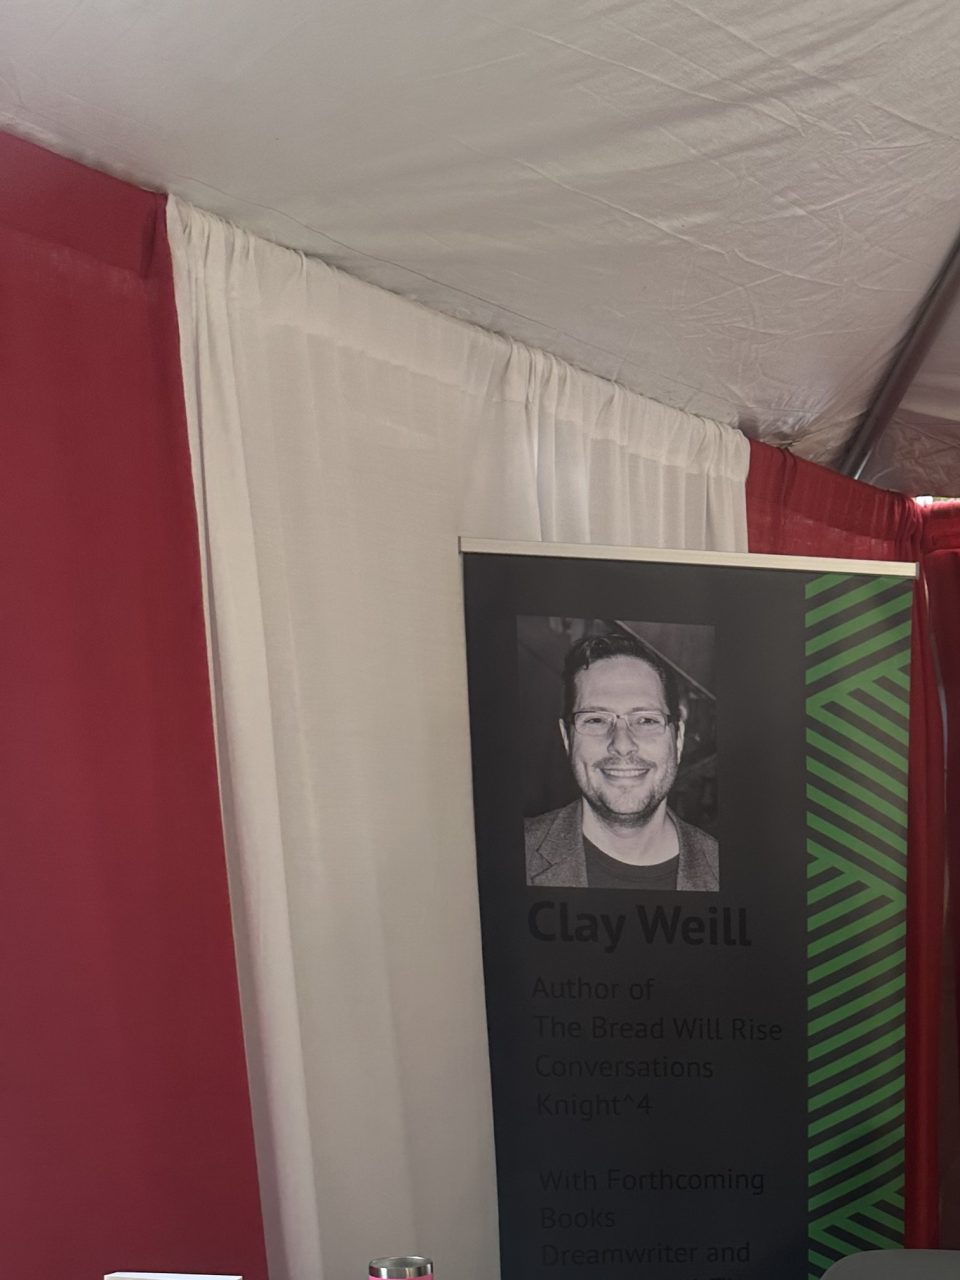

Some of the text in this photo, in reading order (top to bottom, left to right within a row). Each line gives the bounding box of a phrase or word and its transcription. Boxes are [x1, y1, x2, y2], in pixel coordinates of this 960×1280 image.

[528, 900, 752, 953] Clay Weill
[532, 976, 655, 1001] Author of
[534, 1016, 783, 1041] The Bread Will Rise
[535, 1054, 714, 1078] Conversations
[537, 1093, 653, 1121] Knight^4
[539, 1169, 765, 1196] With Forthcoming
[540, 1207, 616, 1229] Books
[541, 1241, 750, 1266] Dreamwriter and
